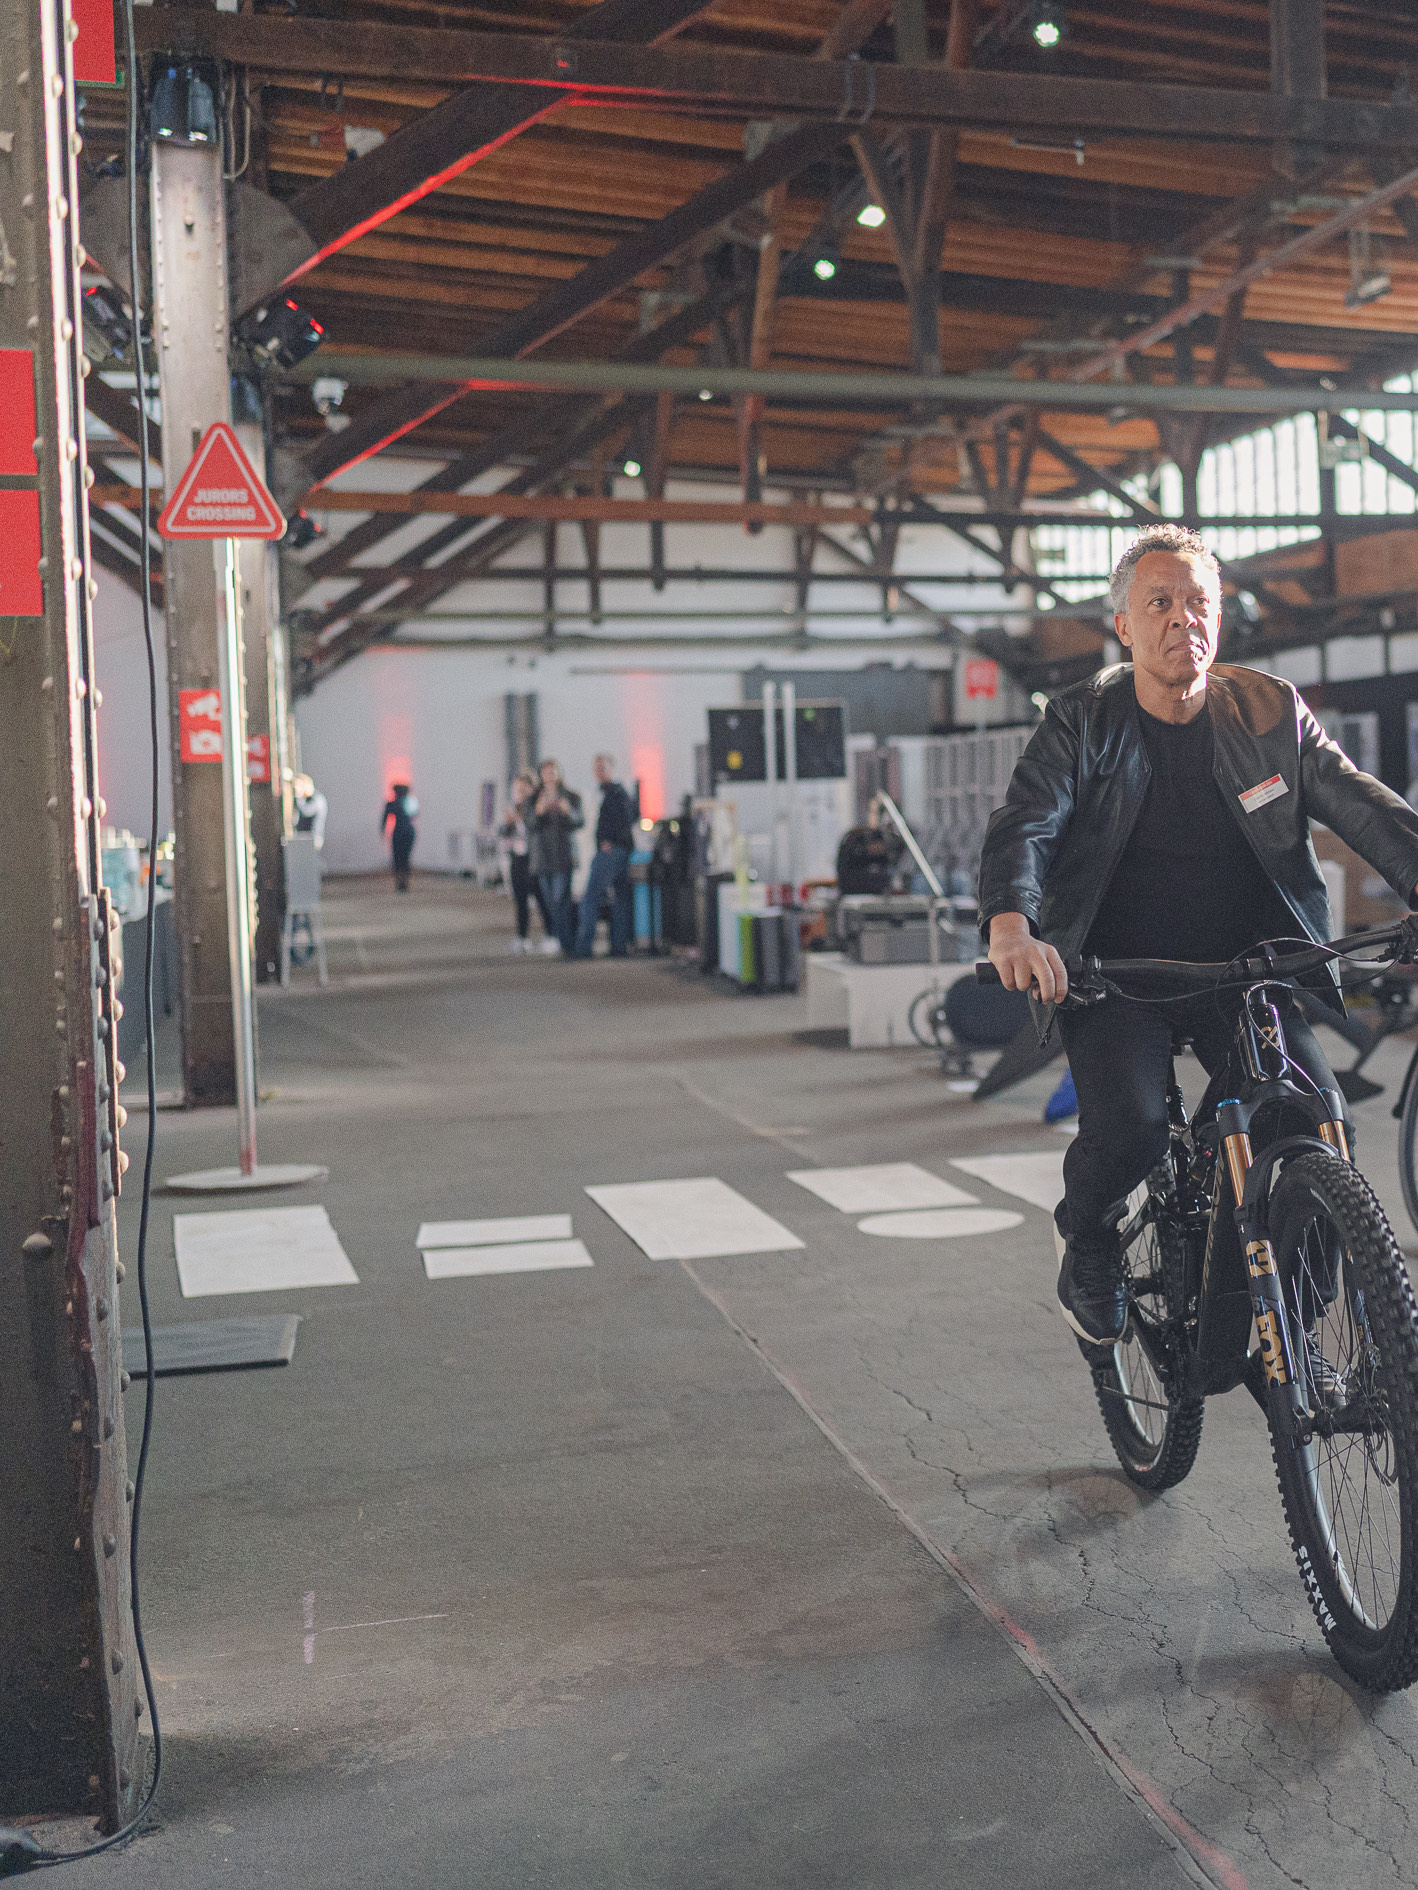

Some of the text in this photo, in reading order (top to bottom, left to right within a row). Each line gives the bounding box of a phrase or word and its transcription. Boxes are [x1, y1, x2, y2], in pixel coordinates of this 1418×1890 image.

[186, 506, 256, 521] CROSSING
[193, 488, 248, 503] JURORS
[1256, 1311, 1287, 1391] FOX
[1298, 1545, 1337, 1631] MAXXIS
